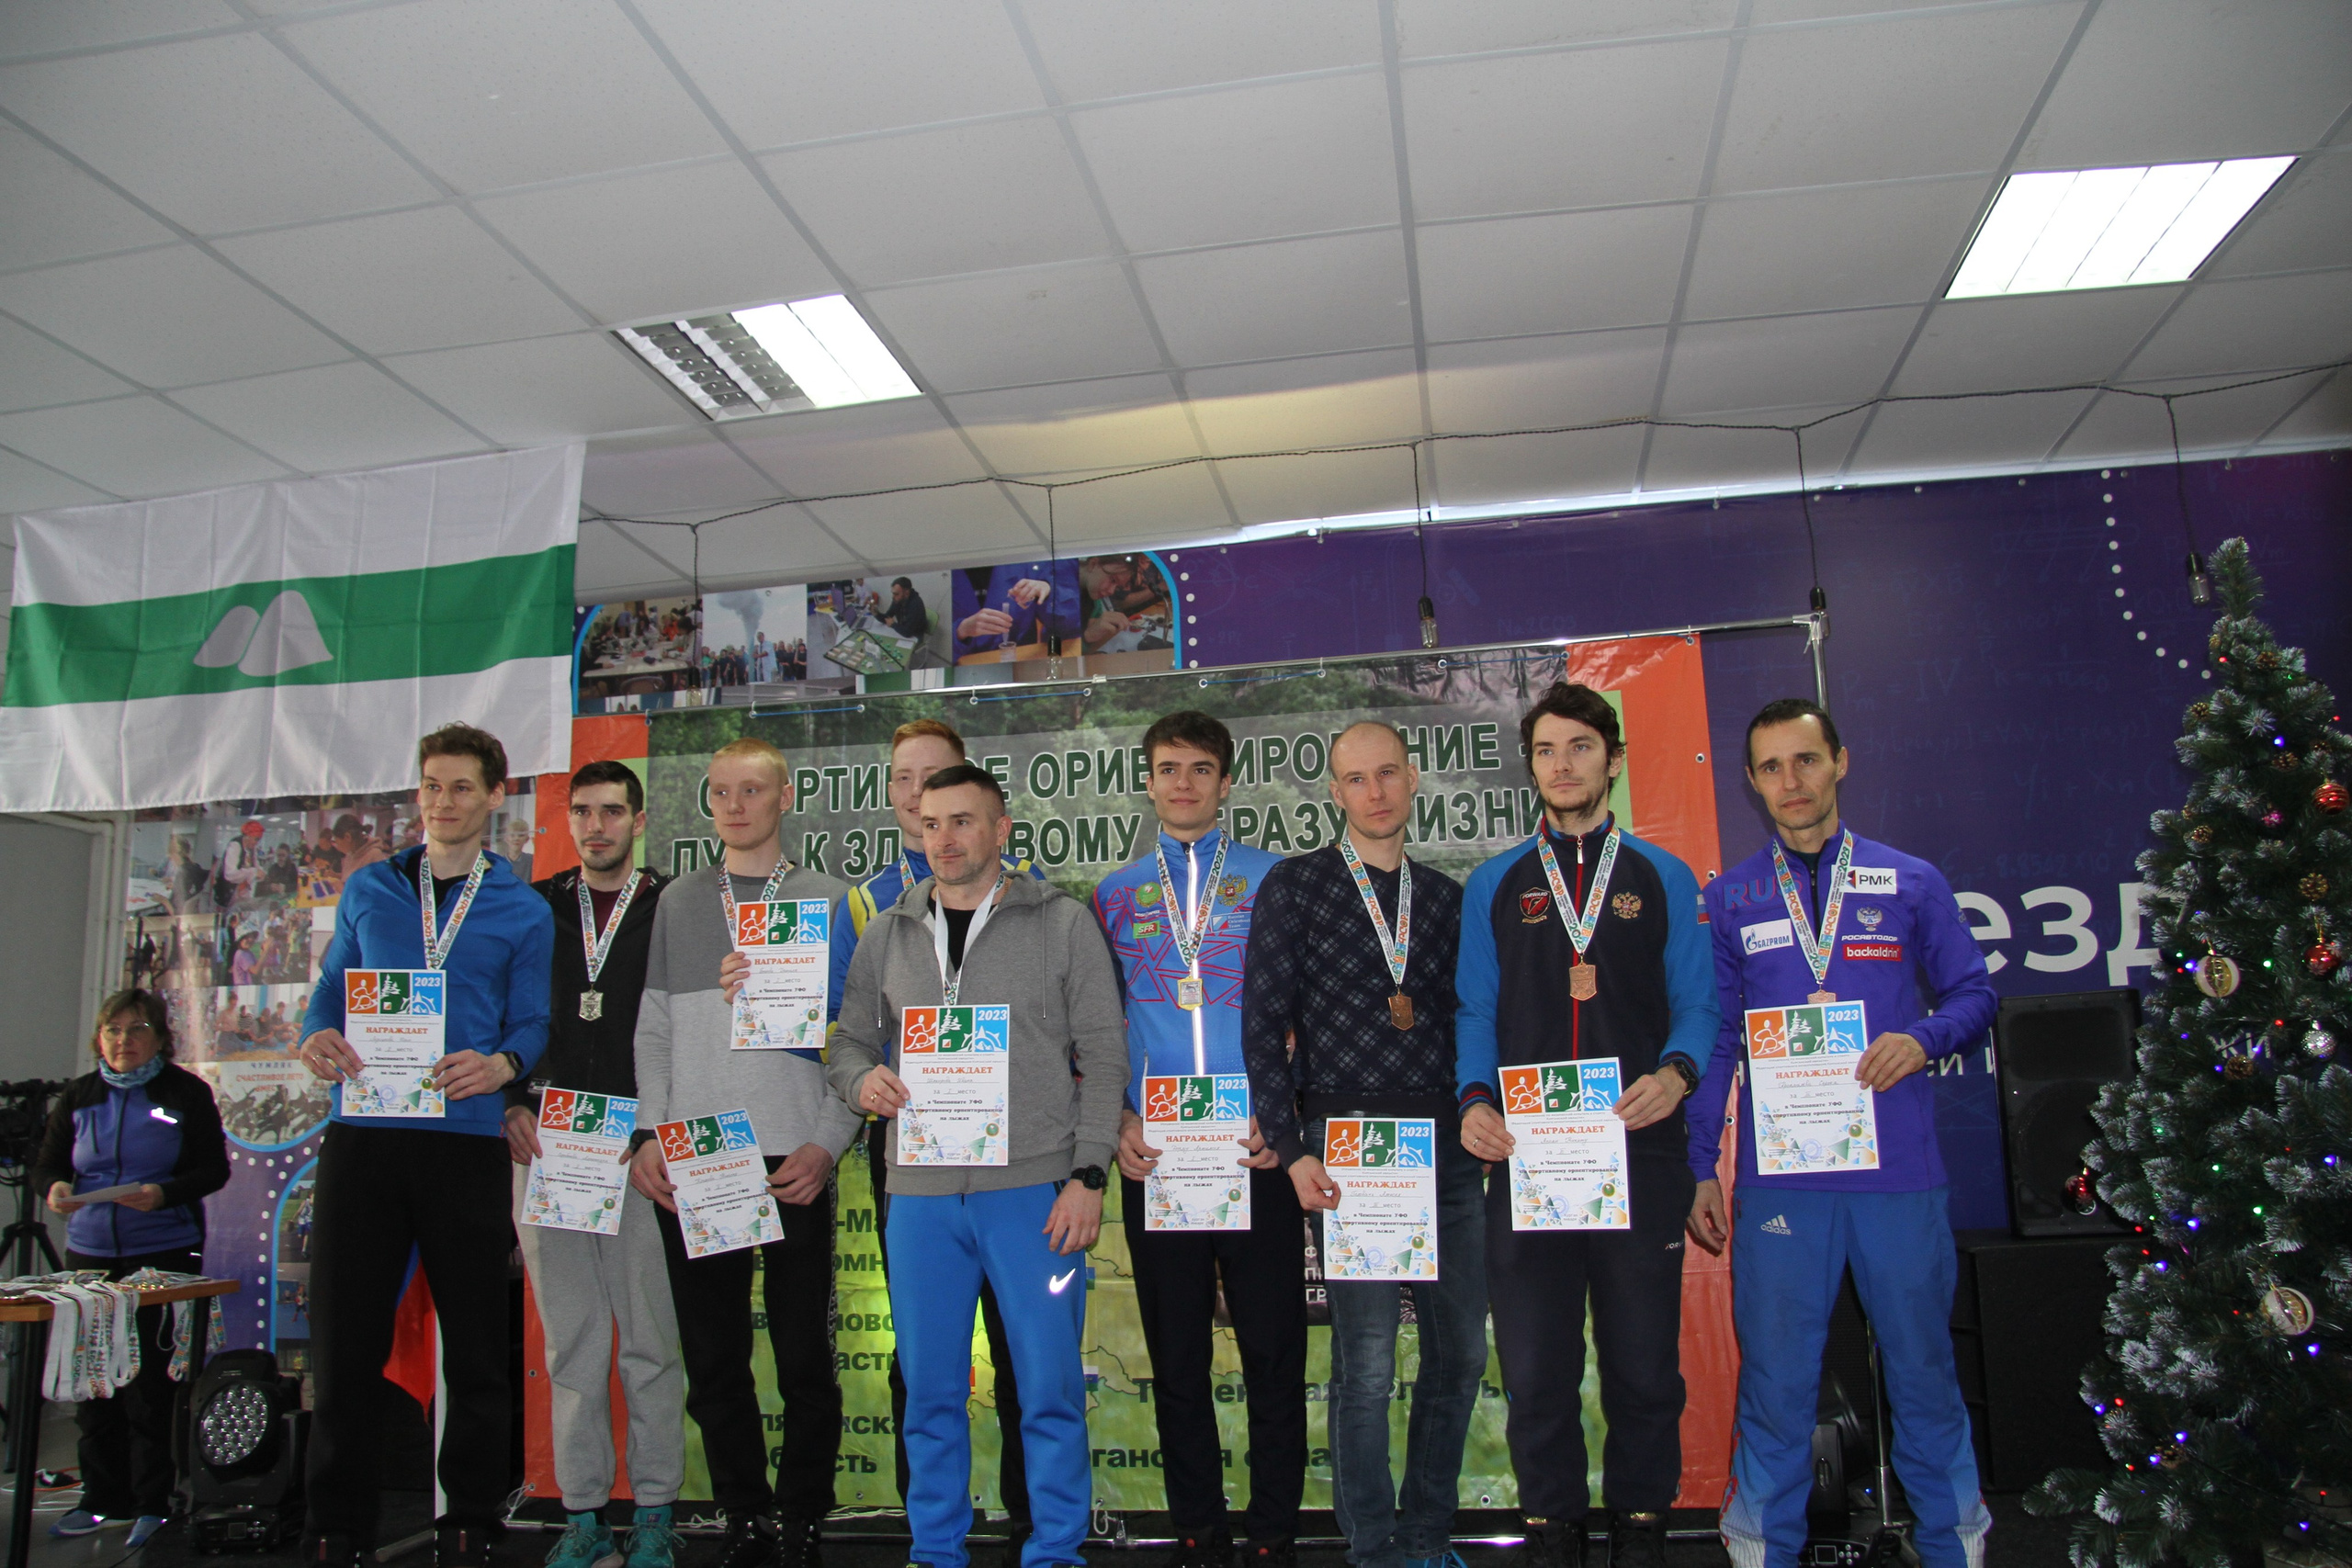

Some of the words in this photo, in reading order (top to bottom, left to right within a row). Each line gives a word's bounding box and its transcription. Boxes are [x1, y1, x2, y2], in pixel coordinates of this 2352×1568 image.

[1603, 835, 1618, 862] 2023
[1212, 852, 1225, 875] 2023
[1838, 846, 1851, 873] 2023
[801, 904, 827, 914] 2023
[1138, 924, 1155, 933] SFR
[1758, 935, 1790, 948] GAZPROM
[1847, 946, 1900, 958] backaldrin
[754, 957, 816, 965] НАГРАЖДАЕТ
[414, 977, 441, 987] 2023
[978, 1010, 1007, 1021] 2023
[1827, 1010, 1859, 1022] 2023
[922, 1066, 993, 1075] НАГРАЖДАЕТ
[1583, 1066, 1615, 1079] 2023
[1775, 1067, 1849, 1079] НАГРАЖДАЕТ
[1217, 1079, 1247, 1089] 2023
[610, 1100, 638, 1112] 2023
[721, 1112, 748, 1125] 2023
[1400, 1126, 1430, 1137] 2023
[1531, 1125, 1605, 1135] НАГРАЖДАЕТ
[1166, 1134, 1235, 1143] НАГРАЖДАЕТ
[555, 1142, 619, 1156] НАГРАЖДАЕТ
[689, 1159, 751, 1177] НАГРАЖДАЕТ
[1347, 1180, 1417, 1189] НАГРАЖДАЕТ
[1760, 1224, 1792, 1235] adidas
